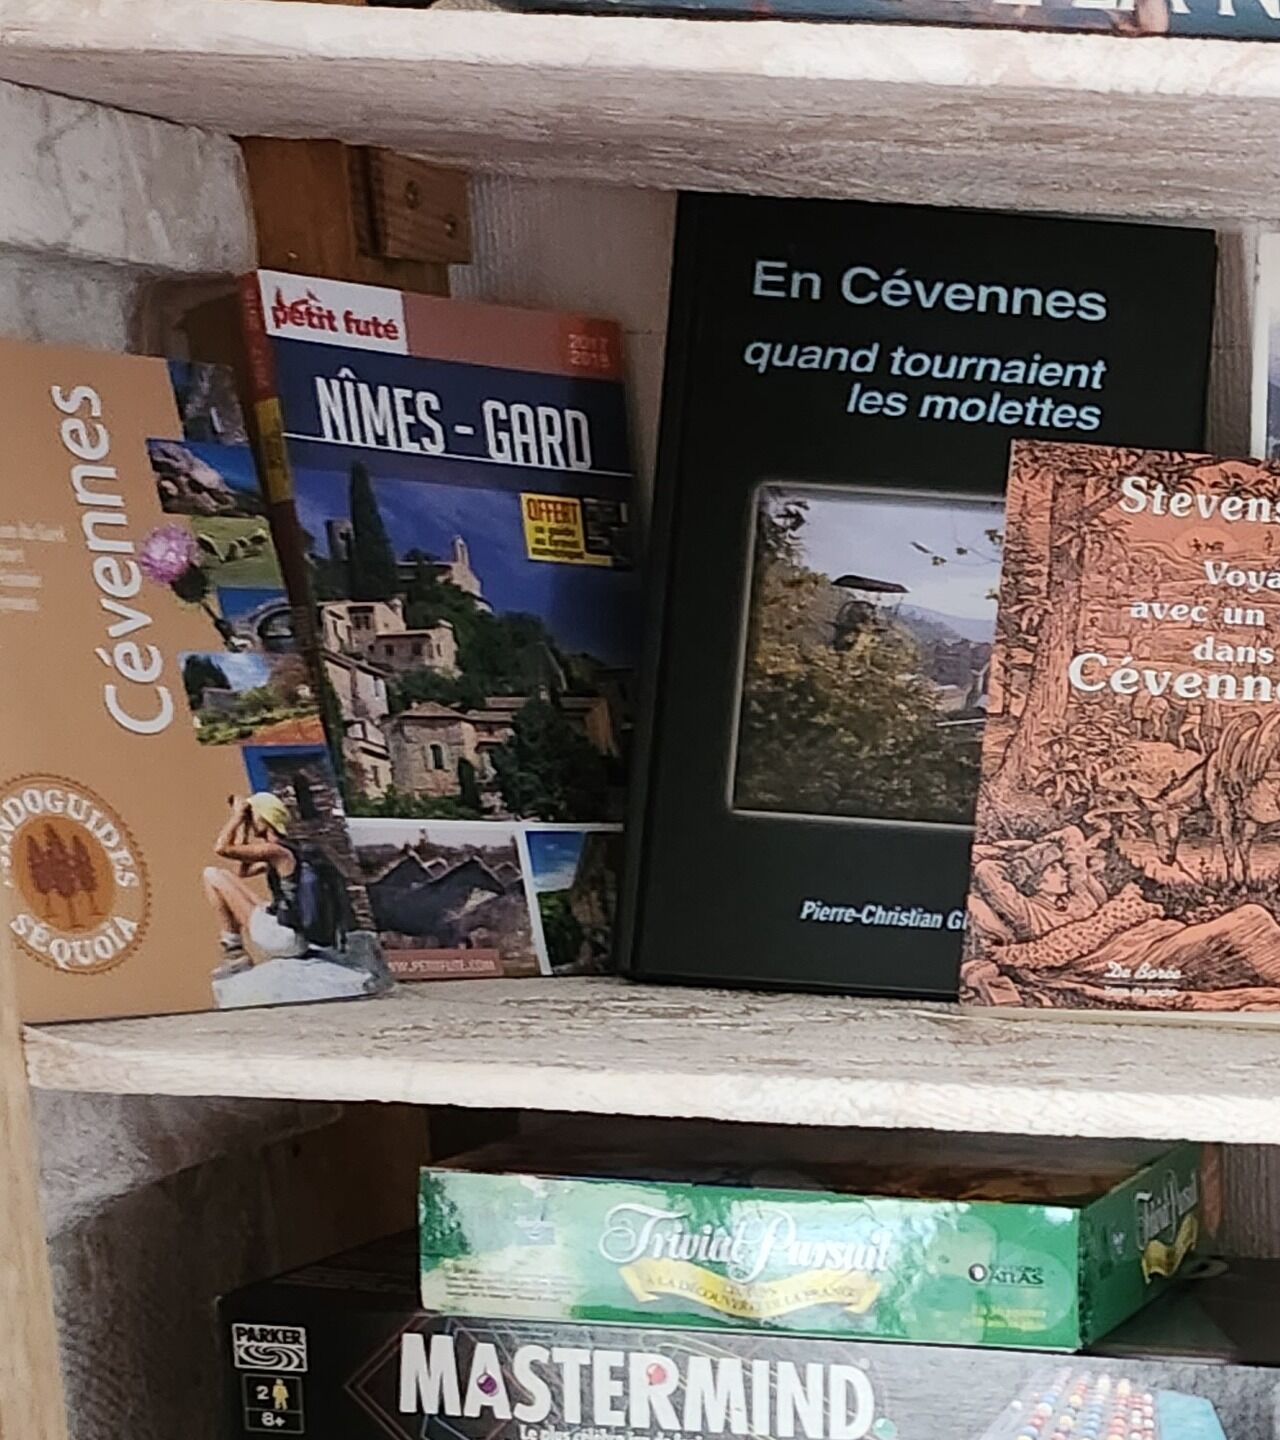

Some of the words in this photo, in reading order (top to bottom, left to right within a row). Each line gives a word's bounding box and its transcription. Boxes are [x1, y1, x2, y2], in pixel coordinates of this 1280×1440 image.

[752, 260, 821, 300] En
[841, 266, 1107, 321] Cévennes
[344, 311, 399, 342] futé
[743, 341, 880, 374] quand
[889, 345, 1107, 390] tournaient
[315, 367, 446, 454] NÎMES
[483, 399, 593, 470] GARD
[846, 383, 907, 417] les
[919, 391, 1101, 431] molettes
[51, 385, 174, 735] Cévennes
[1130, 601, 1208, 623] avec
[1223, 605, 1266, 627] un
[1193, 637, 1275, 665] dans
[800, 900, 943, 931] Pierre-Christian
[10, 913, 140, 980] SEQUOIA
[600, 1202, 742, 1264] Trivial
[726, 1208, 892, 1283] Pursuit
[989, 1271, 1044, 1285] ATLAS
[236, 1326, 304, 1345] PARKER
[256, 1384, 268, 1400] 2
[519, 1424, 537, 1440] Le
